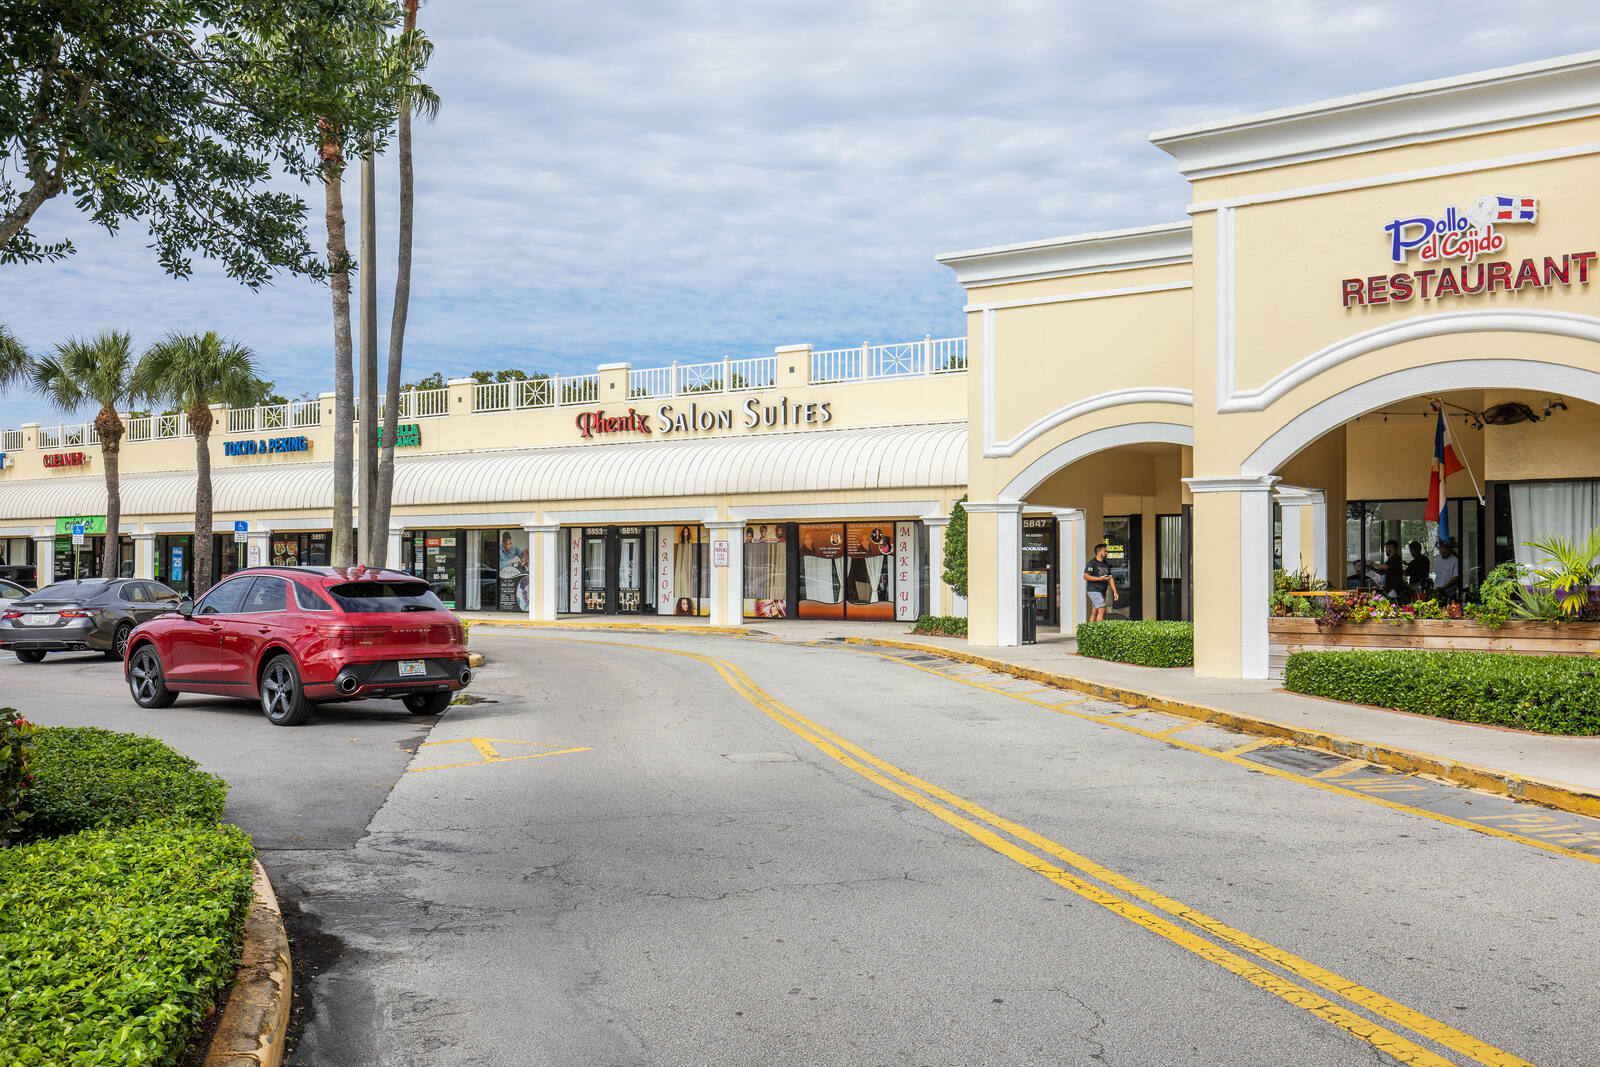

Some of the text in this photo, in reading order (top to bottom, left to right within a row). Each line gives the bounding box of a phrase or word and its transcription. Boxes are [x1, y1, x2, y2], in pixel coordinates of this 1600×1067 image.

[1384, 206, 1469, 263] Pollo
[1421, 224, 1504, 262] el Cojido
[1342, 251, 1597, 308] RESTAURANT
[223, 436, 308, 457] TOKYO & PEKING
[575, 408, 651, 438] Phenix
[572, 537, 581, 604] NAILS
[662, 538, 672, 604] SALON
